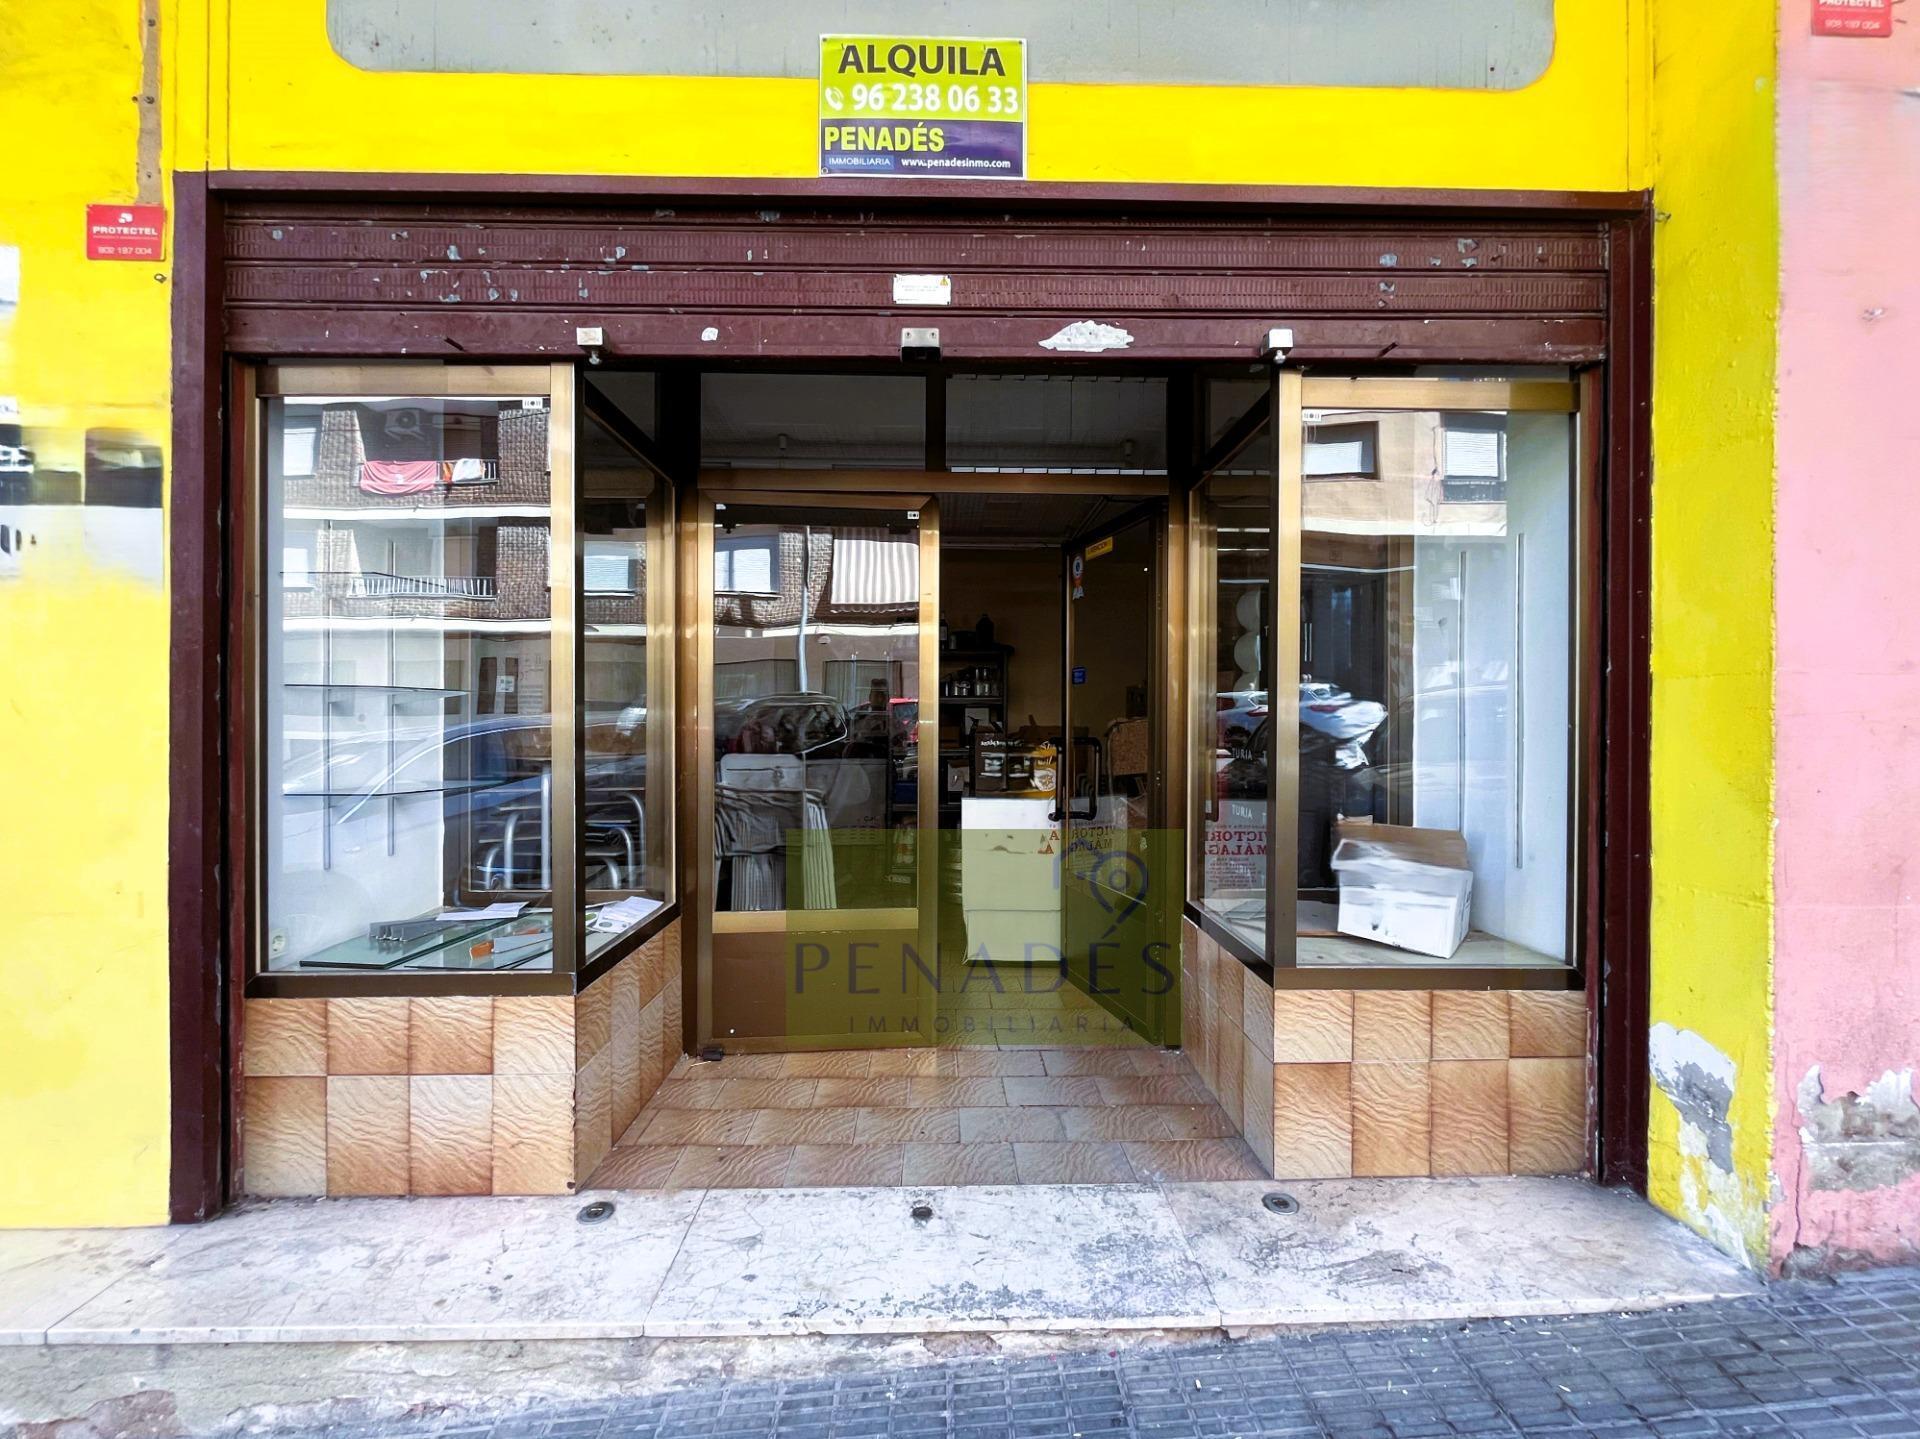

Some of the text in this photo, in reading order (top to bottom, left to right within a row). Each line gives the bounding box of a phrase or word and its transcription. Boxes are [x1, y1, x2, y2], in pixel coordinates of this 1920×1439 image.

[837, 44, 1006, 77] ALQUILA
[852, 84, 1018, 115] 96 238 06 33
[824, 122, 945, 152] PENADÉS
[828, 157, 891, 166] IMMOBILIARIA
[901, 157, 1011, 168] www.penadesinmo.com
[92, 226, 158, 236] PROTECTEL
[118, 247, 133, 255] 197
[134, 247, 152, 255] 004
[1231, 748, 1252, 761] TURIA
[1231, 804, 1253, 820] TURIA
